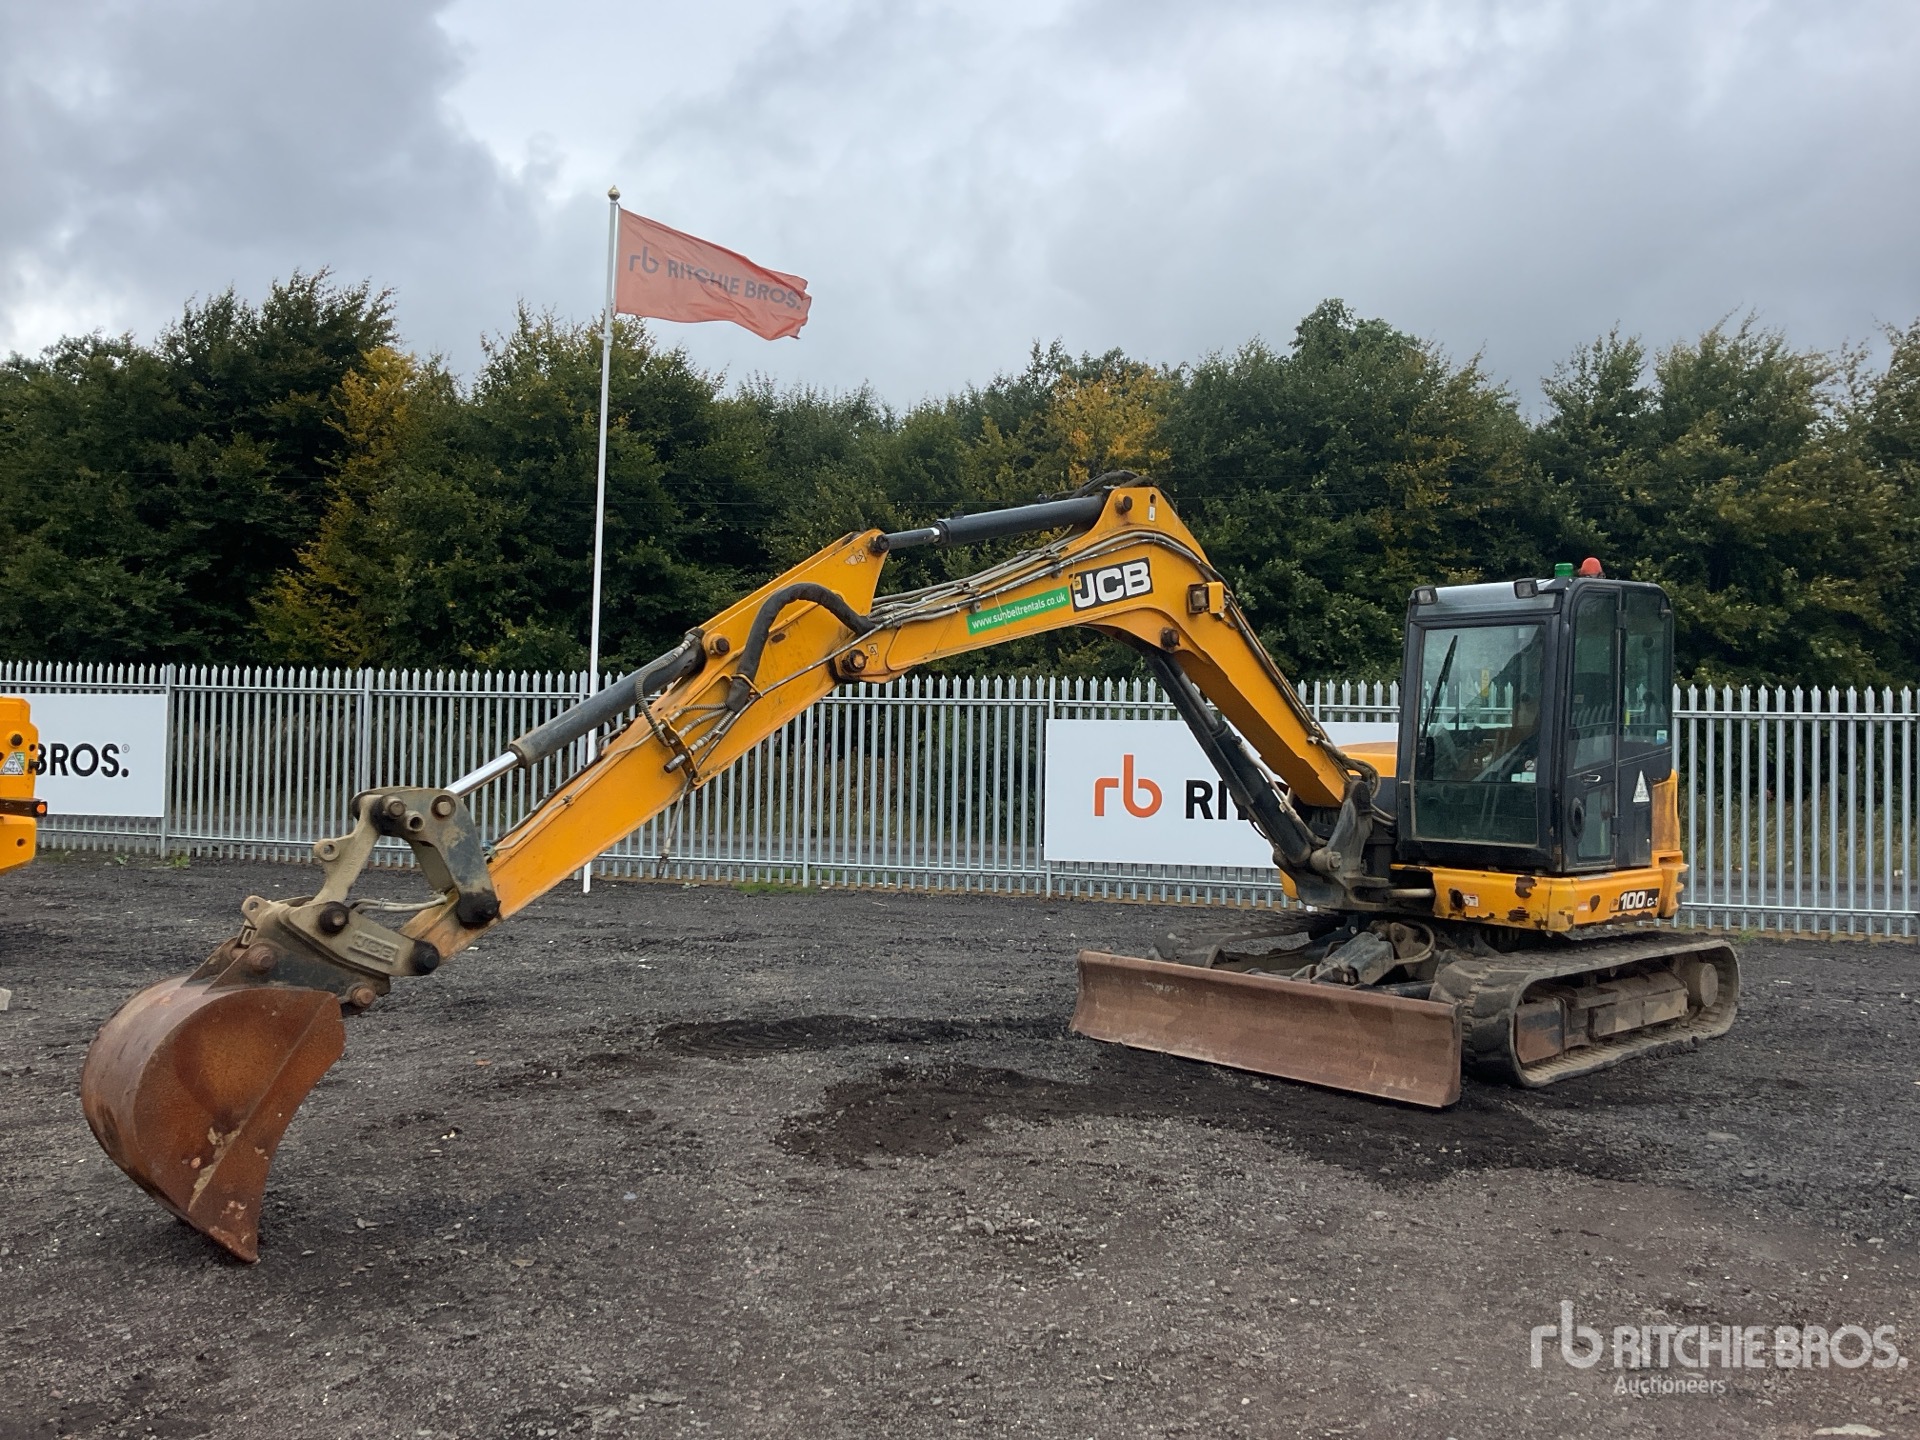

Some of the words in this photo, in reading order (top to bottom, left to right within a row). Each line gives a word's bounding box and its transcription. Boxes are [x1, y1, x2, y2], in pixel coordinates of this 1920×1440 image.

[666, 259, 740, 295] RITCHIE
[1074, 561, 1151, 608] JCB
[971, 592, 1066, 630] www.sunbeltrentals.co.uk
[1094, 754, 1163, 818] rb
[1620, 891, 1645, 910] 100
